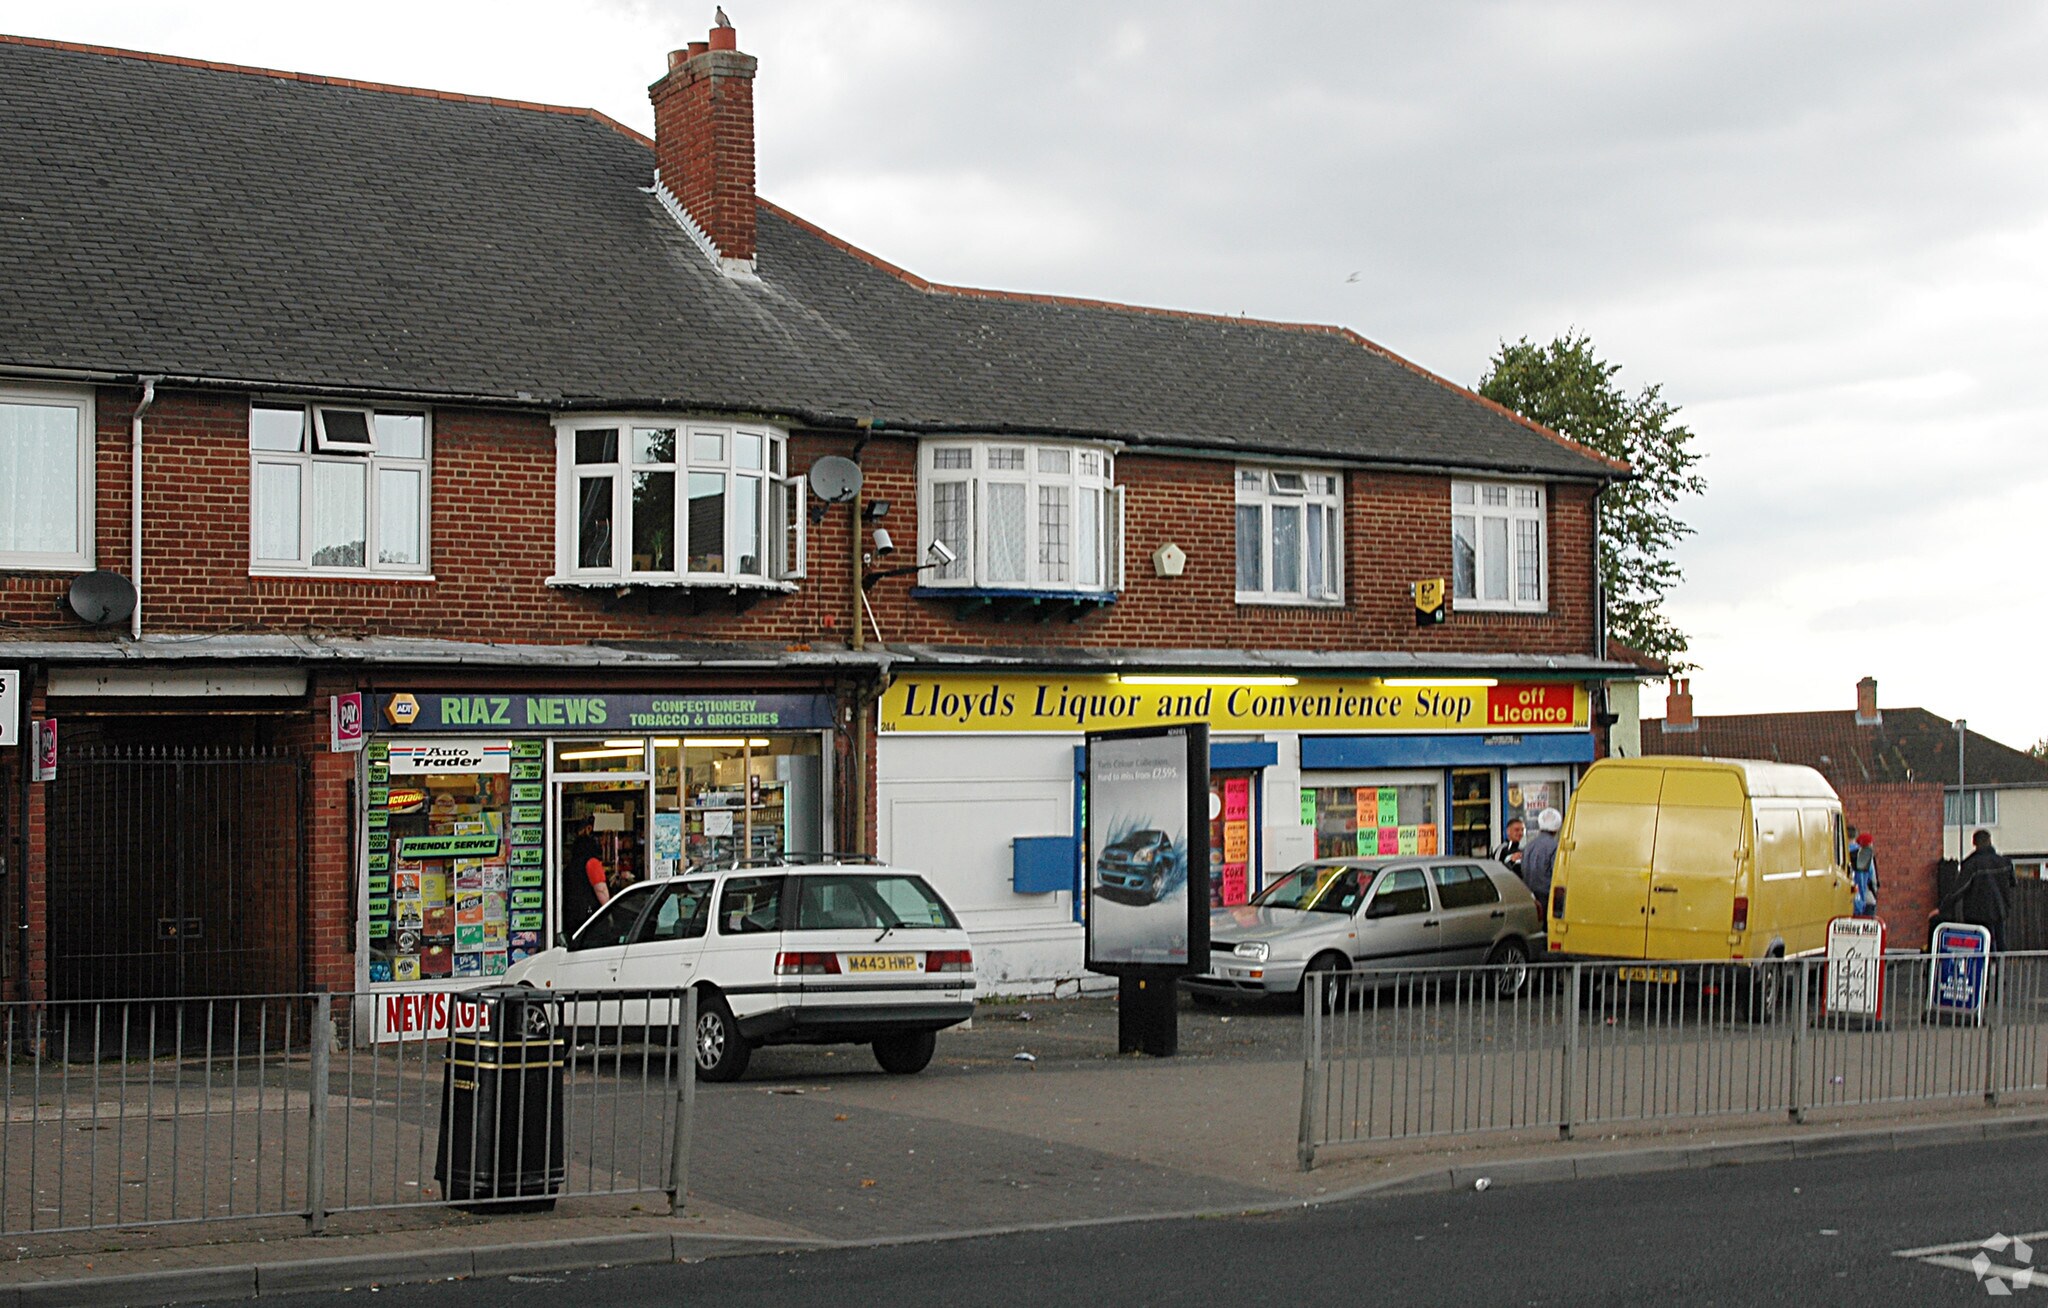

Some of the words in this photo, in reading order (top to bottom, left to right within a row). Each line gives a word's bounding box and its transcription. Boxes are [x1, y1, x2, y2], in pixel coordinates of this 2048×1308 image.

[1519, 688, 1546, 704] off
[396, 703, 413, 714] ADT
[441, 697, 511, 725] RIAZ
[526, 698, 607, 725] NEWS
[652, 700, 757, 713] CONFECTIONERY
[902, 684, 1015, 723] Lloyds
[1032, 685, 1141, 724] Liquor
[1157, 688, 1212, 718] and
[1227, 686, 1402, 718] Convenience
[1414, 688, 1472, 724] Stop
[341, 704, 357, 728] PAY
[630, 713, 689, 726] TOBACCO
[694, 714, 703, 725] &
[707, 712, 779, 725] GROCERIES
[1493, 704, 1568, 723] Licence
[881, 722, 896, 732] 244
[426, 747, 469, 757] Auto
[412, 758, 482, 766] Trader
[403, 842, 452, 851] FRIENDLY
[454, 840, 495, 849] SERVICE
[1833, 922, 1861, 936] Evening
[1862, 923, 1879, 935] Mail
[850, 956, 886, 971] M443
[889, 956, 915, 969] HWP
